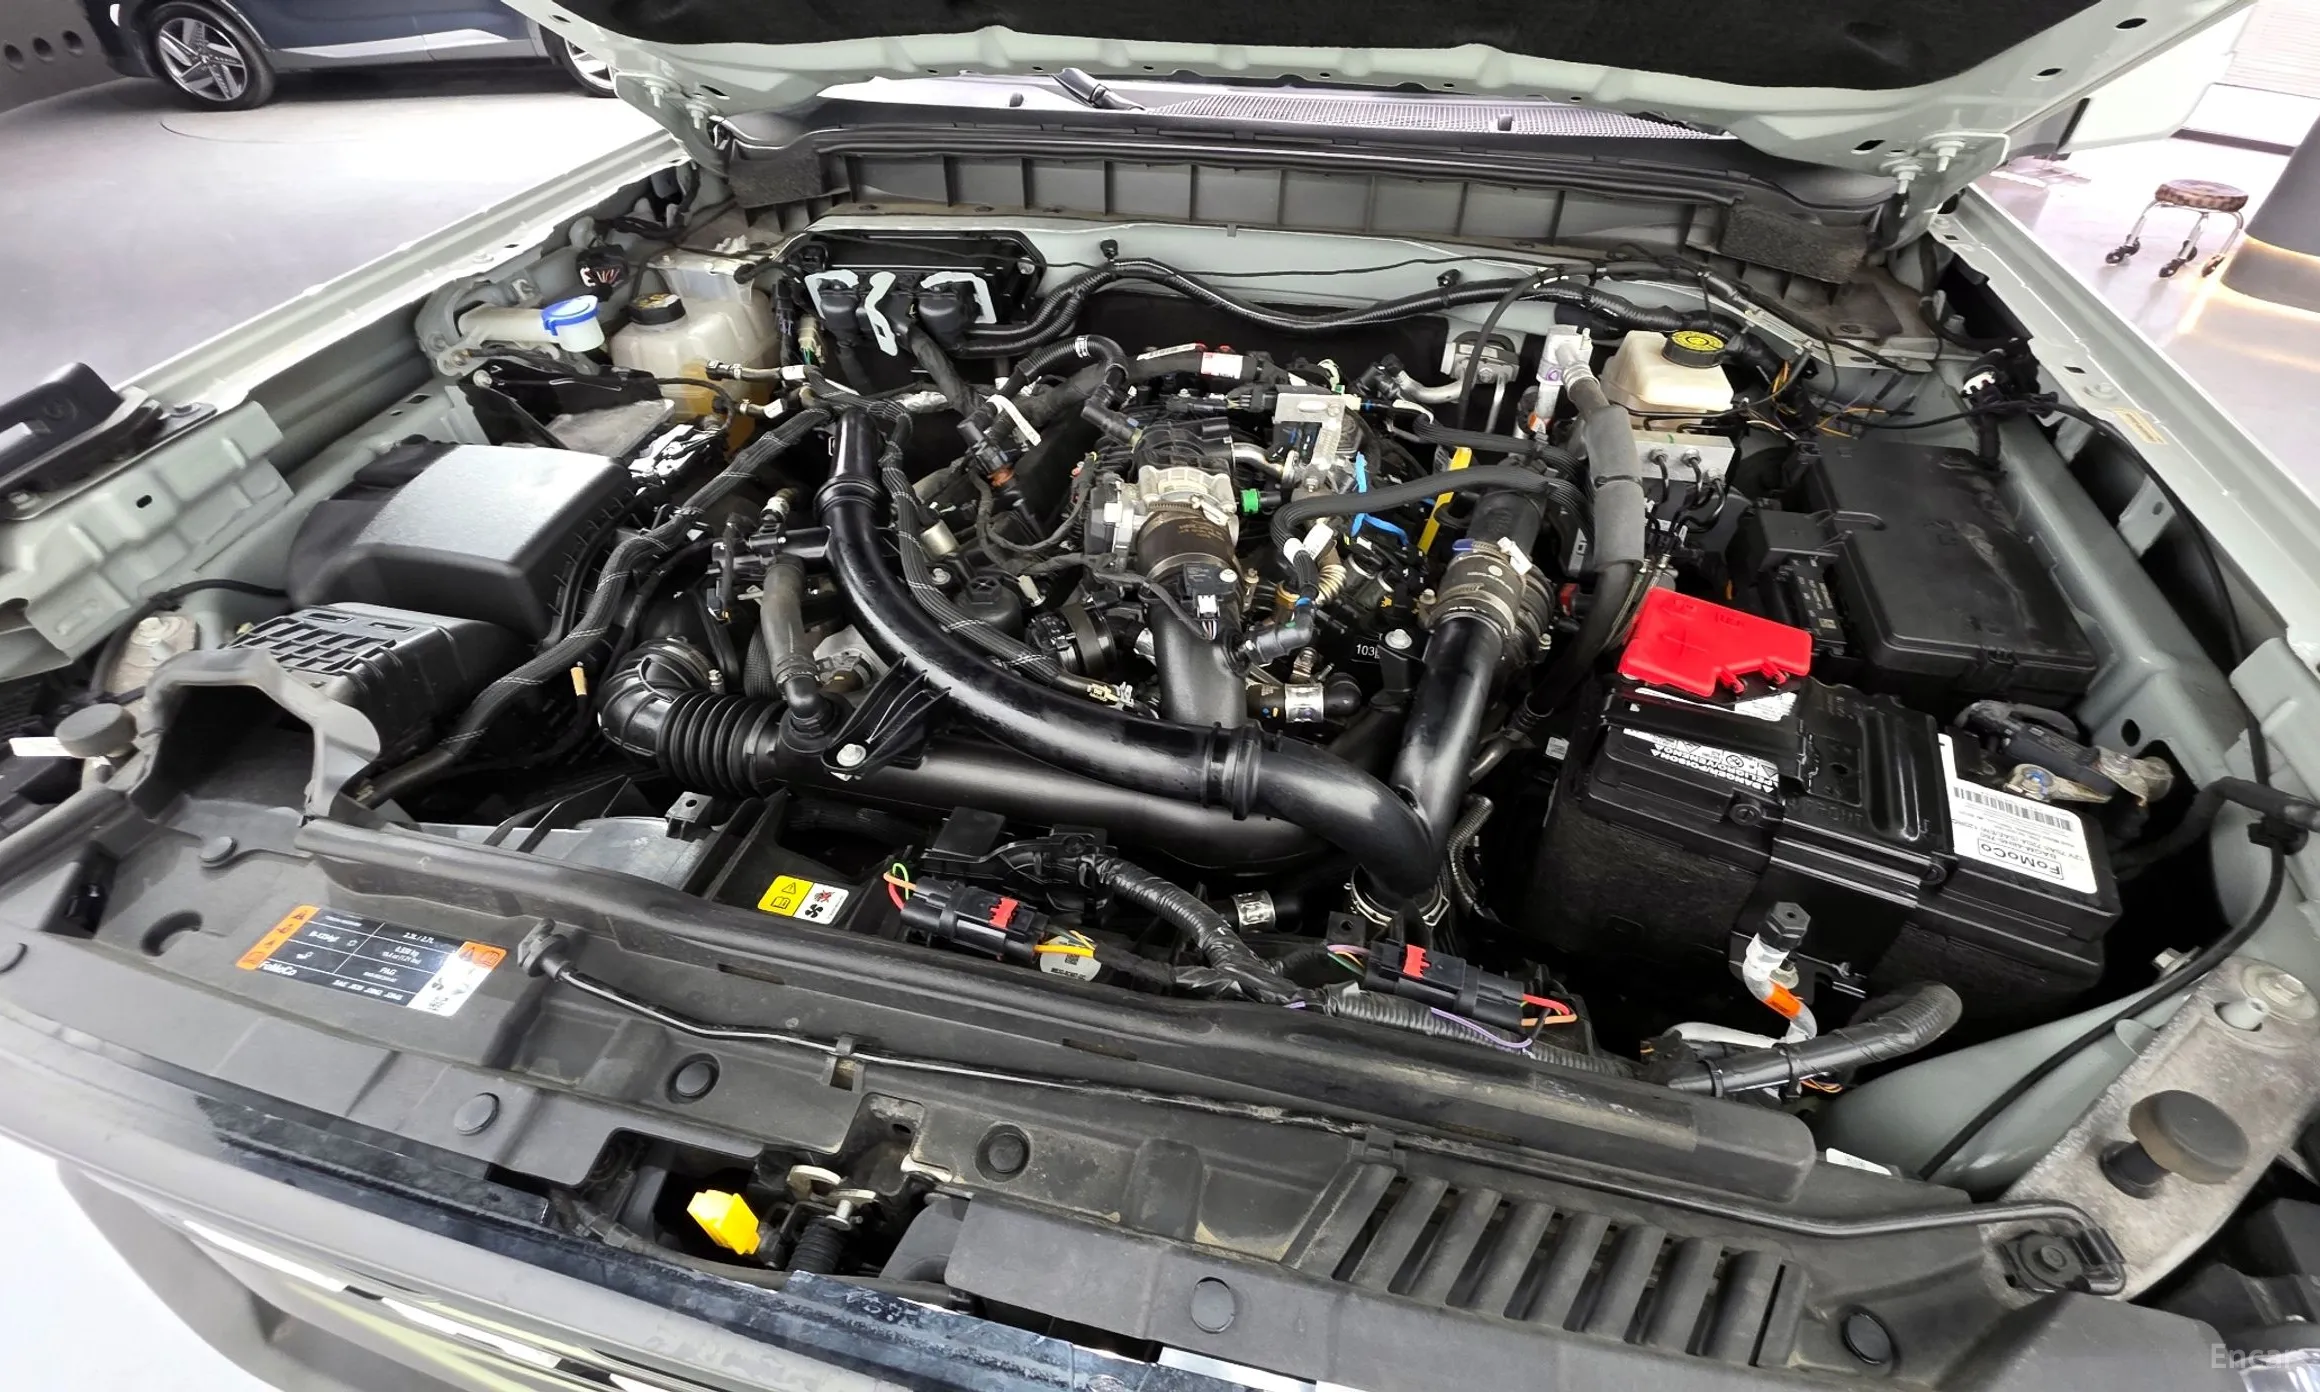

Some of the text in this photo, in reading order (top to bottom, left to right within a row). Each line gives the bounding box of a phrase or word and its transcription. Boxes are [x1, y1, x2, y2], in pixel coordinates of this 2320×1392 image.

[1660, 752, 1762, 790] DANGER/POISON
[1663, 745, 1773, 787] PELIGRO/VENENO
[1980, 842, 2060, 875] FoMoCo
[258, 961, 298, 976] FoMoCo
